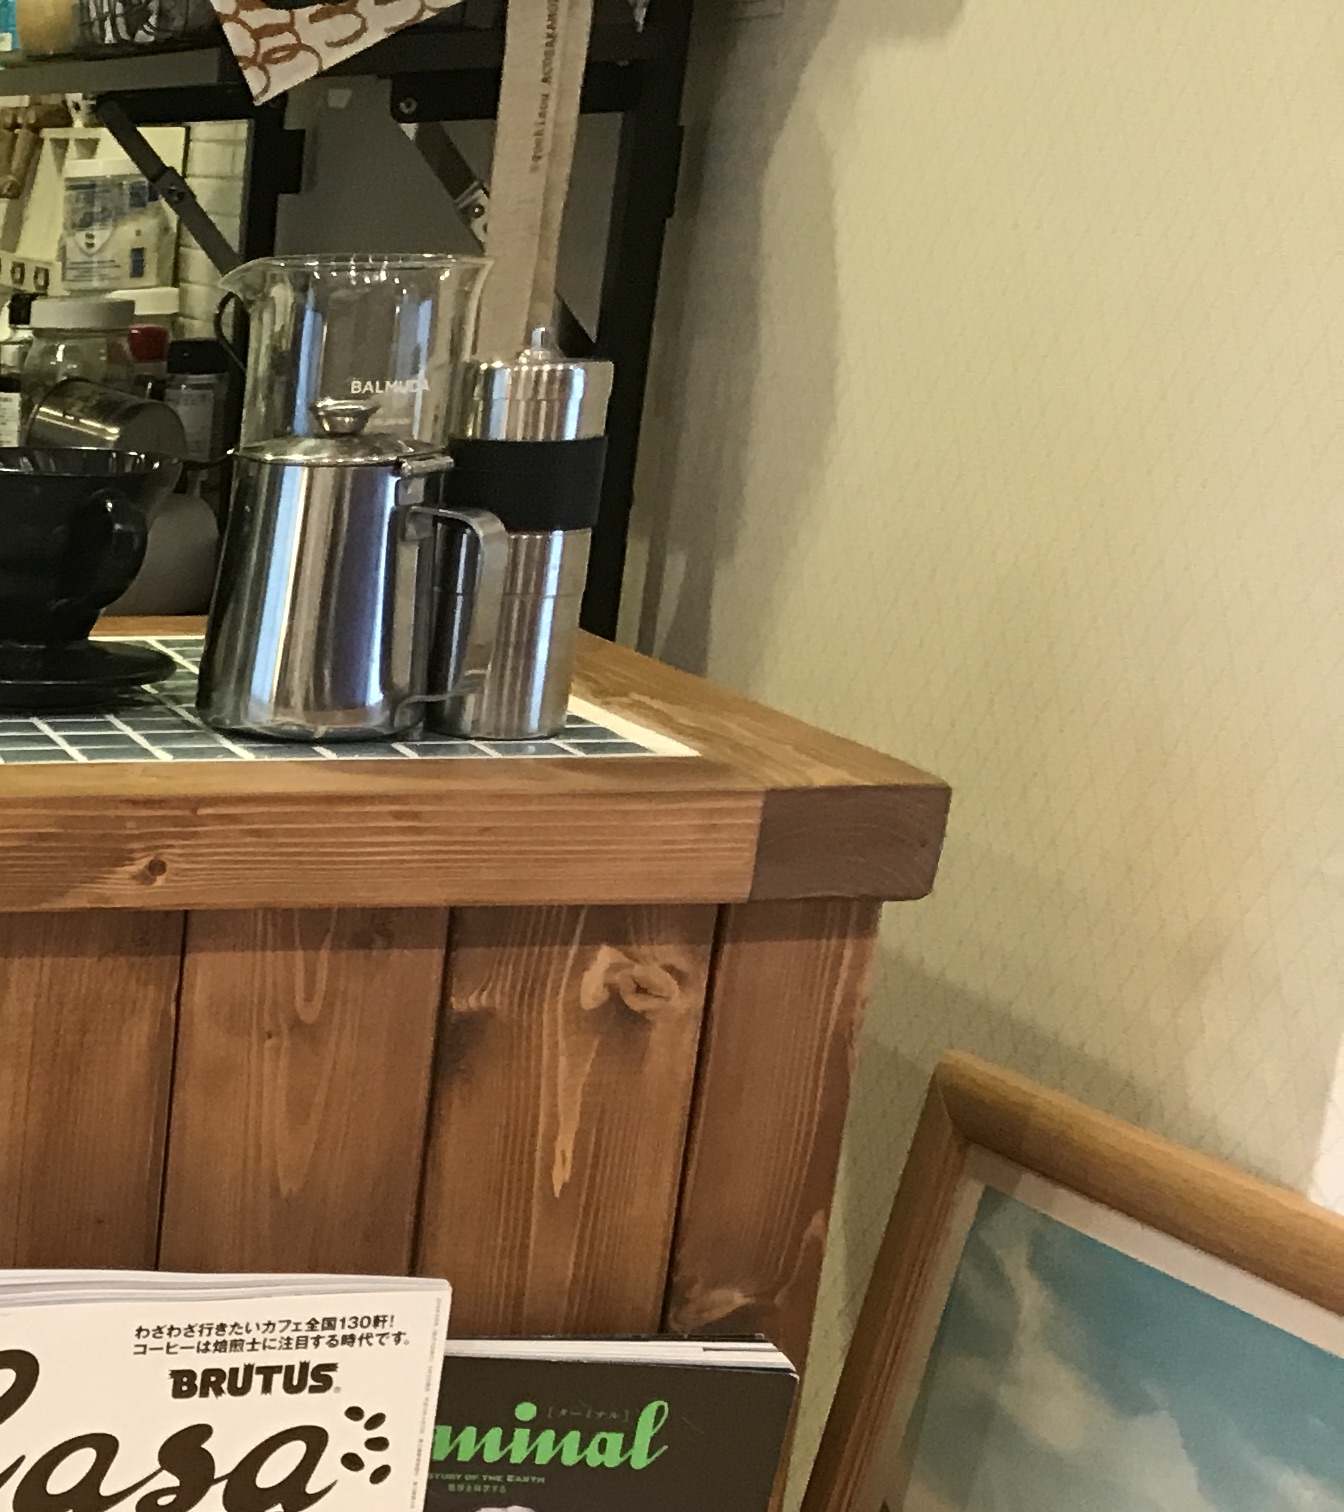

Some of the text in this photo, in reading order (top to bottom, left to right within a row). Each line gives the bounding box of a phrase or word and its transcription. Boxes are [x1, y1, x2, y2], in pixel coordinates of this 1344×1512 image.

[168, 1360, 340, 1400] BRUTUS
[482, 1473, 503, 1483] THE
[506, 1474, 546, 1484] EARTH
